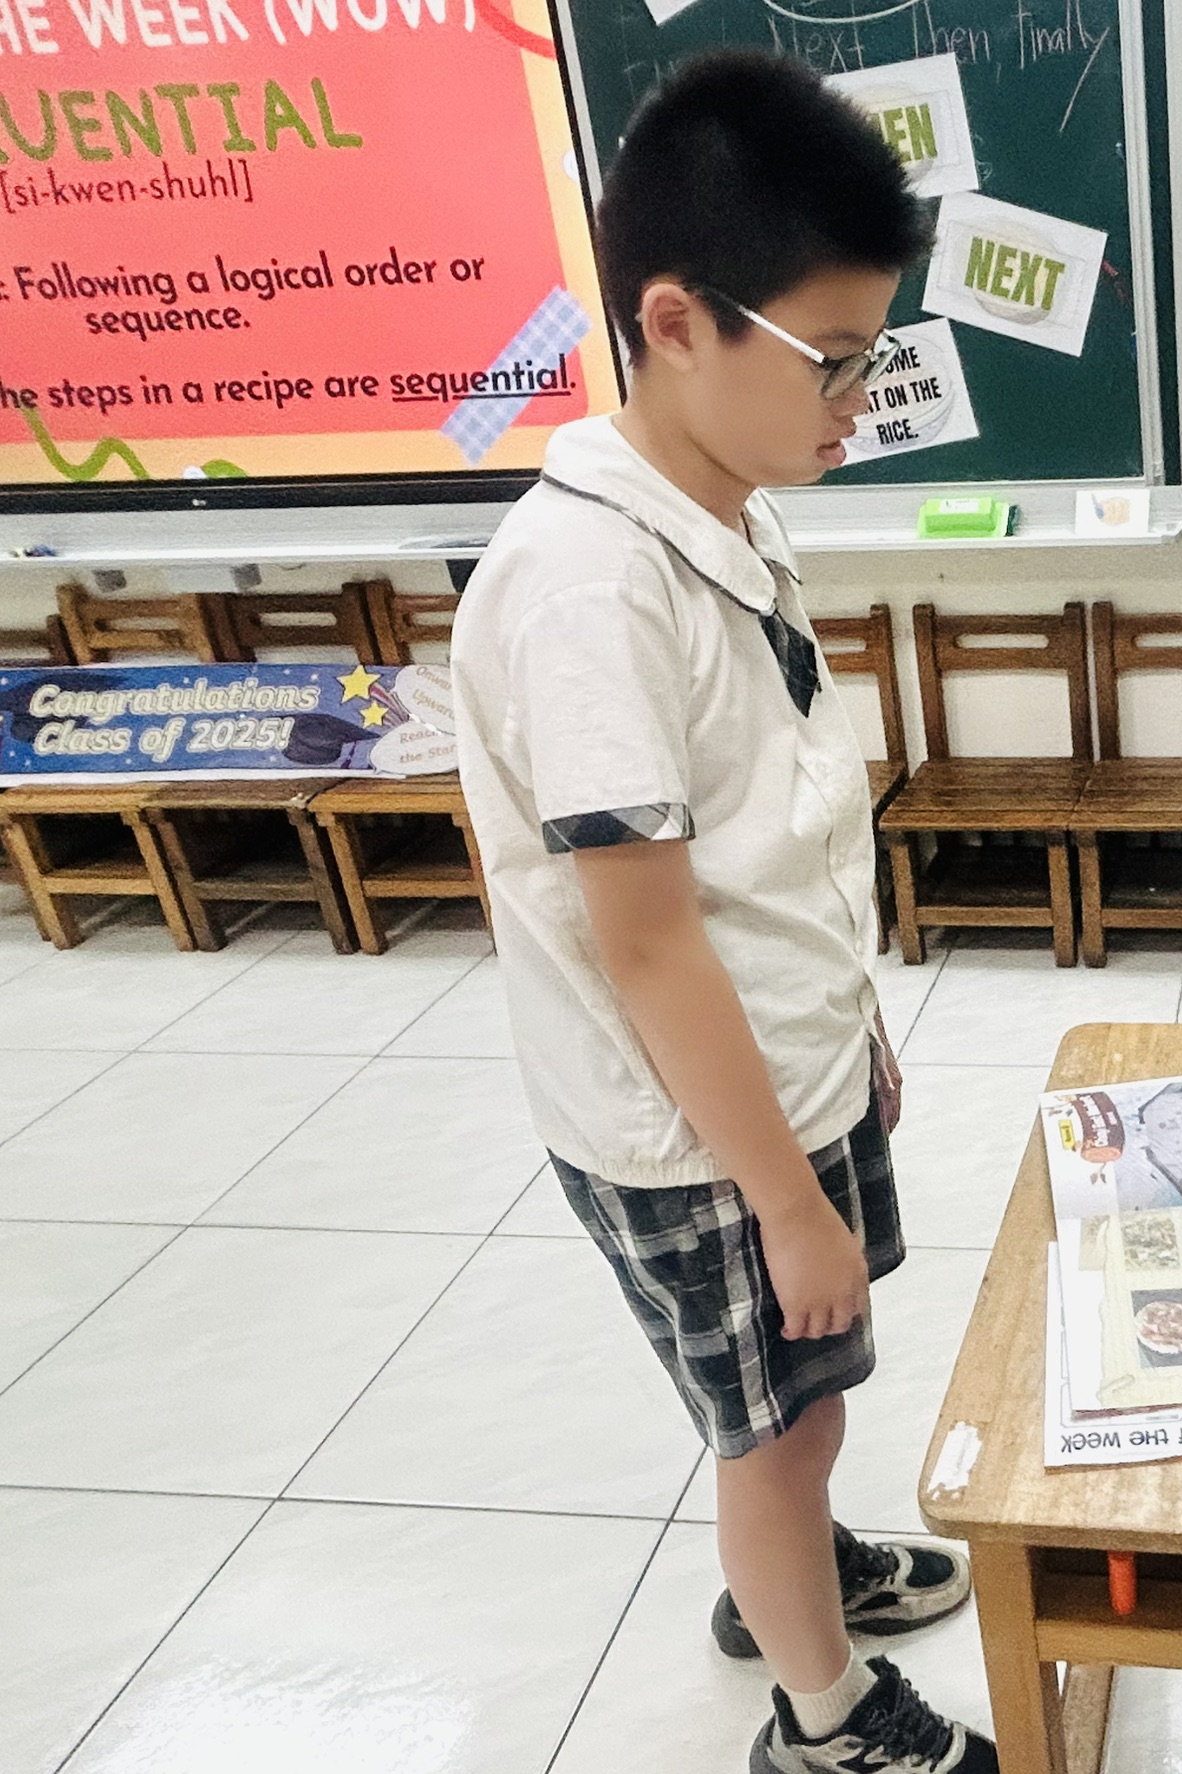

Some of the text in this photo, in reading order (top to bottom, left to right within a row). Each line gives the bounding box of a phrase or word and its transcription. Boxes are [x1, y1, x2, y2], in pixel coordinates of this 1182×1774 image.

[66, 0, 249, 48] WEEK
[265, 0, 476, 45] (WOW)
[0, 77, 363, 163] UENTIAL
[13, 260, 178, 304] Following
[186, 271, 210, 294] a
[215, 249, 334, 300] logical
[344, 246, 437, 287] order
[450, 257, 485, 281] or
[964, 235, 1066, 311] NEXT
[86, 307, 250, 341] sequence.
[48, 378, 133, 415] steps
[139, 375, 172, 404] in
[182, 381, 203, 404] a
[214, 370, 314, 409] recipe
[325, 375, 379, 398] are
[390, 353, 577, 403] sequential.
[884, 384, 908, 409] ON
[909, 377, 942, 403] THE
[876, 419, 919, 445] RICE.
[29, 677, 320, 724] Congratulations
[33, 716, 295, 763] Class of 2025!
